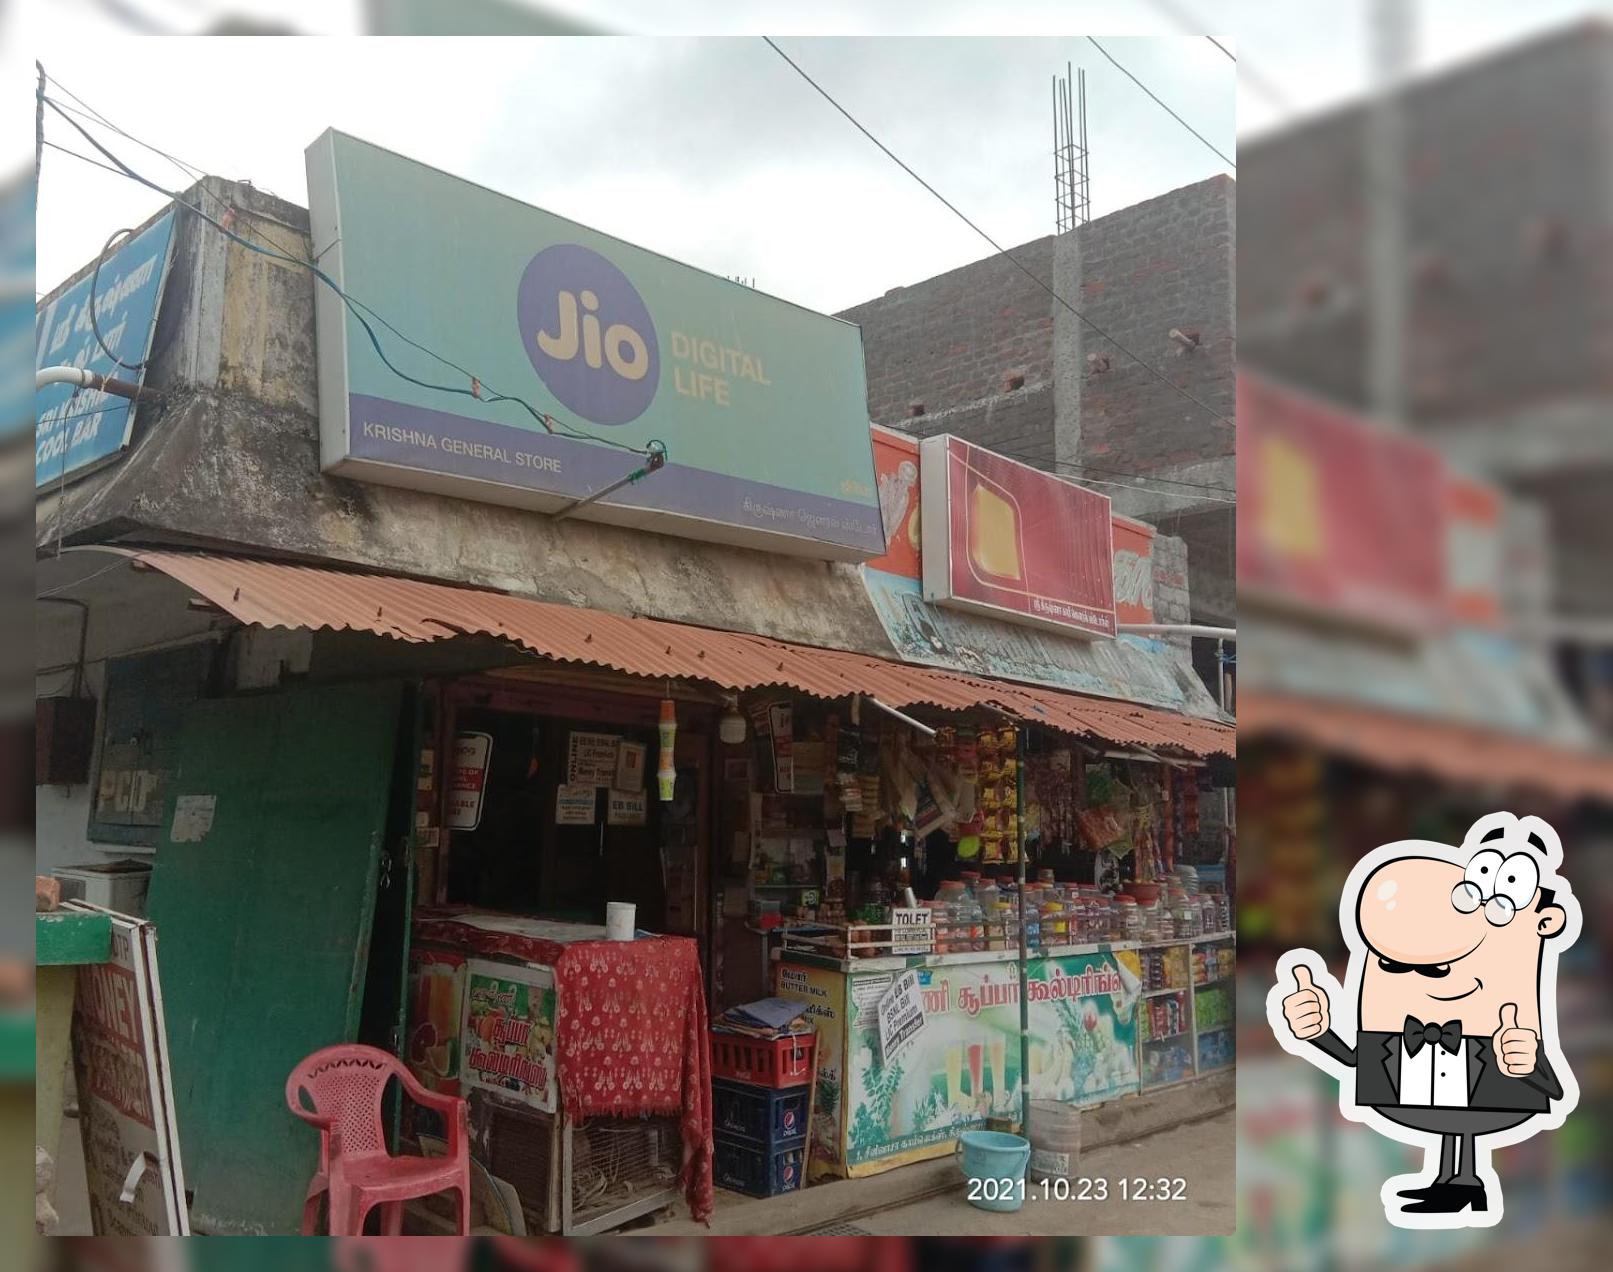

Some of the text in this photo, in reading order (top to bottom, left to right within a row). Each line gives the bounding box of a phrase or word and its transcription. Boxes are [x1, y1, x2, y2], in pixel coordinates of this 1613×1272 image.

[536, 289, 650, 381] Jio
[671, 330, 772, 386] DIGITAL
[674, 366, 731, 407] LIFE
[71, 411, 103, 447] BAR
[363, 421, 562, 473] KRISHNA GENERAL STORE
[780, 980, 808, 994] BUTTER
